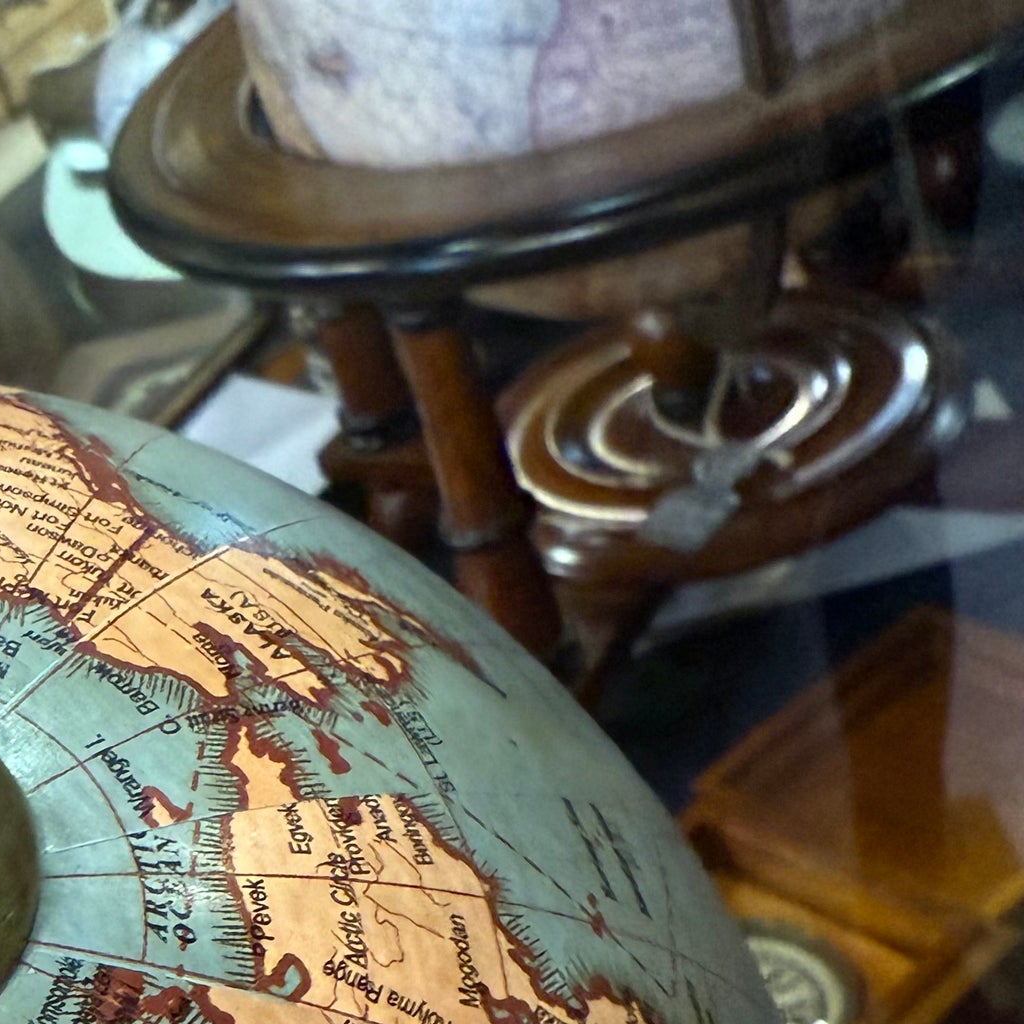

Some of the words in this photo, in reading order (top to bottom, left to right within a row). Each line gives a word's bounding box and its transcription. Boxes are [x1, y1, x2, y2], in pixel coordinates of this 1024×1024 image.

[85, 512, 125, 535] Fort
[200, 587, 292, 661] ALASKA
[242, 878, 276, 942] Pevek
